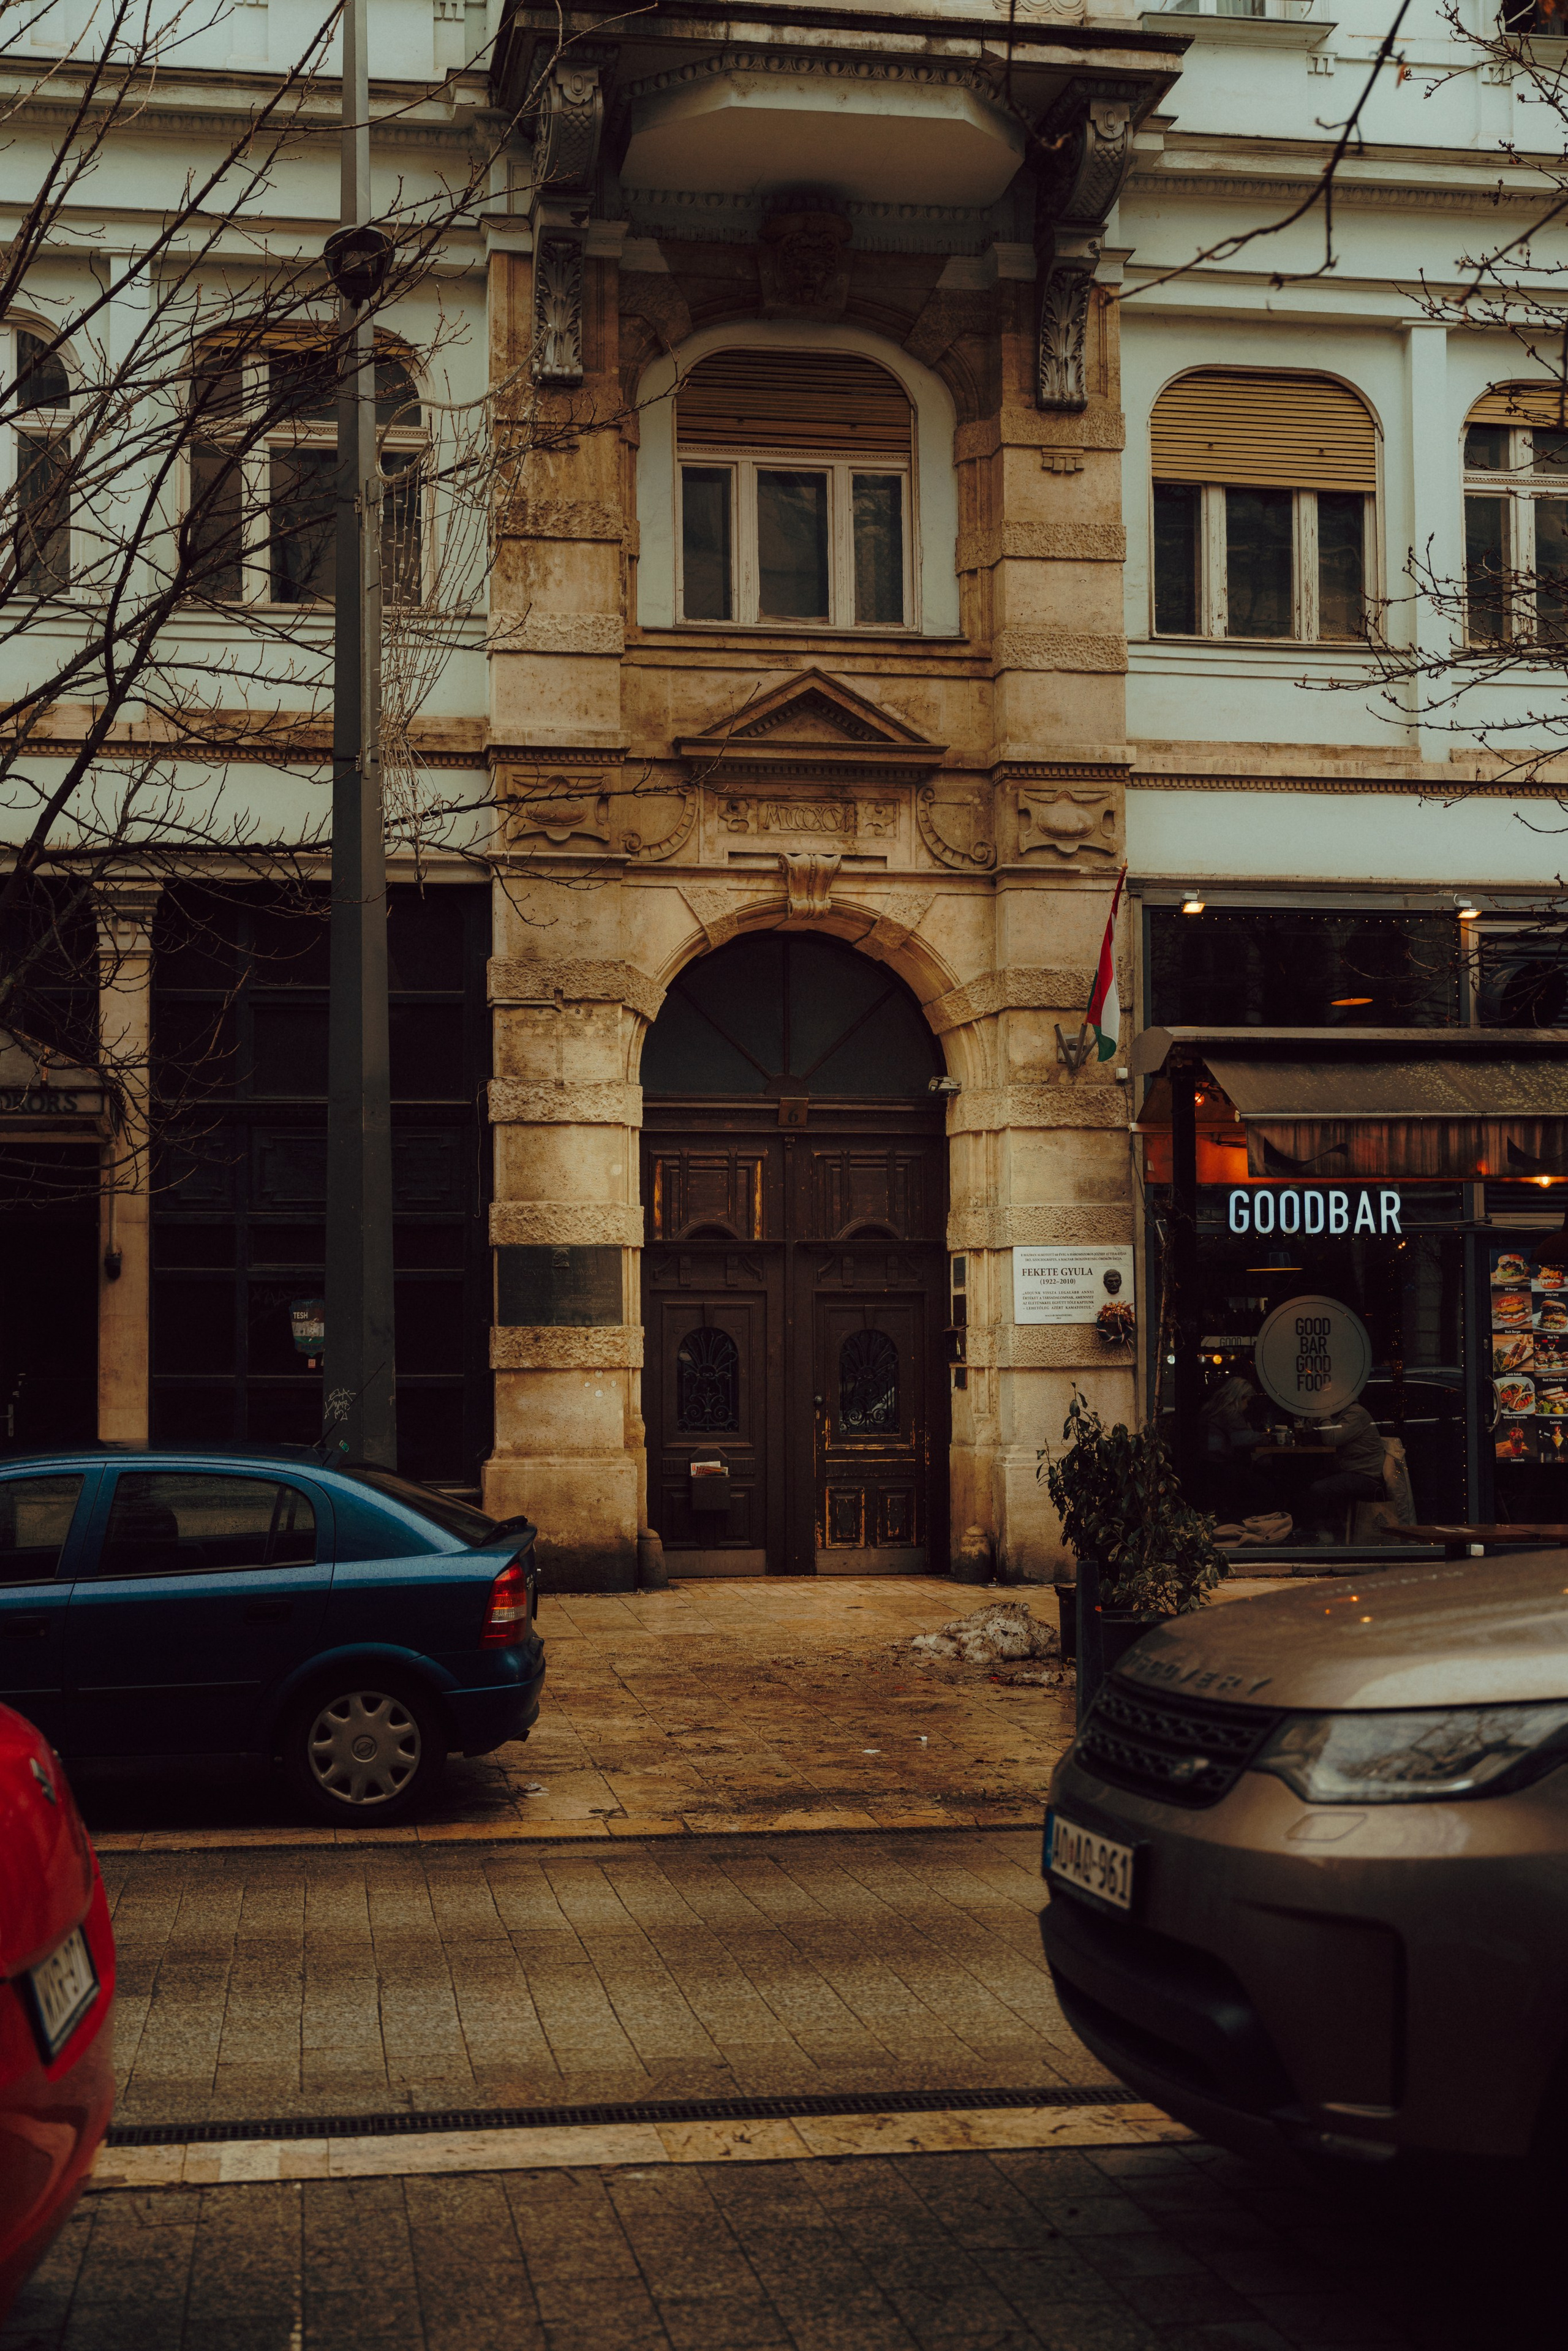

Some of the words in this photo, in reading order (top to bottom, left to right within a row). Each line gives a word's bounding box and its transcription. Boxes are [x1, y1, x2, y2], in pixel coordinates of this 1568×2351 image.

[1229, 1190, 1401, 1234] GOODBAR
[1295, 1318, 1330, 1335] GOOD
[1300, 1337, 1327, 1354] BAR
[1296, 1355, 1331, 1373] GOOD
[1297, 1374, 1331, 1391] FOOD
